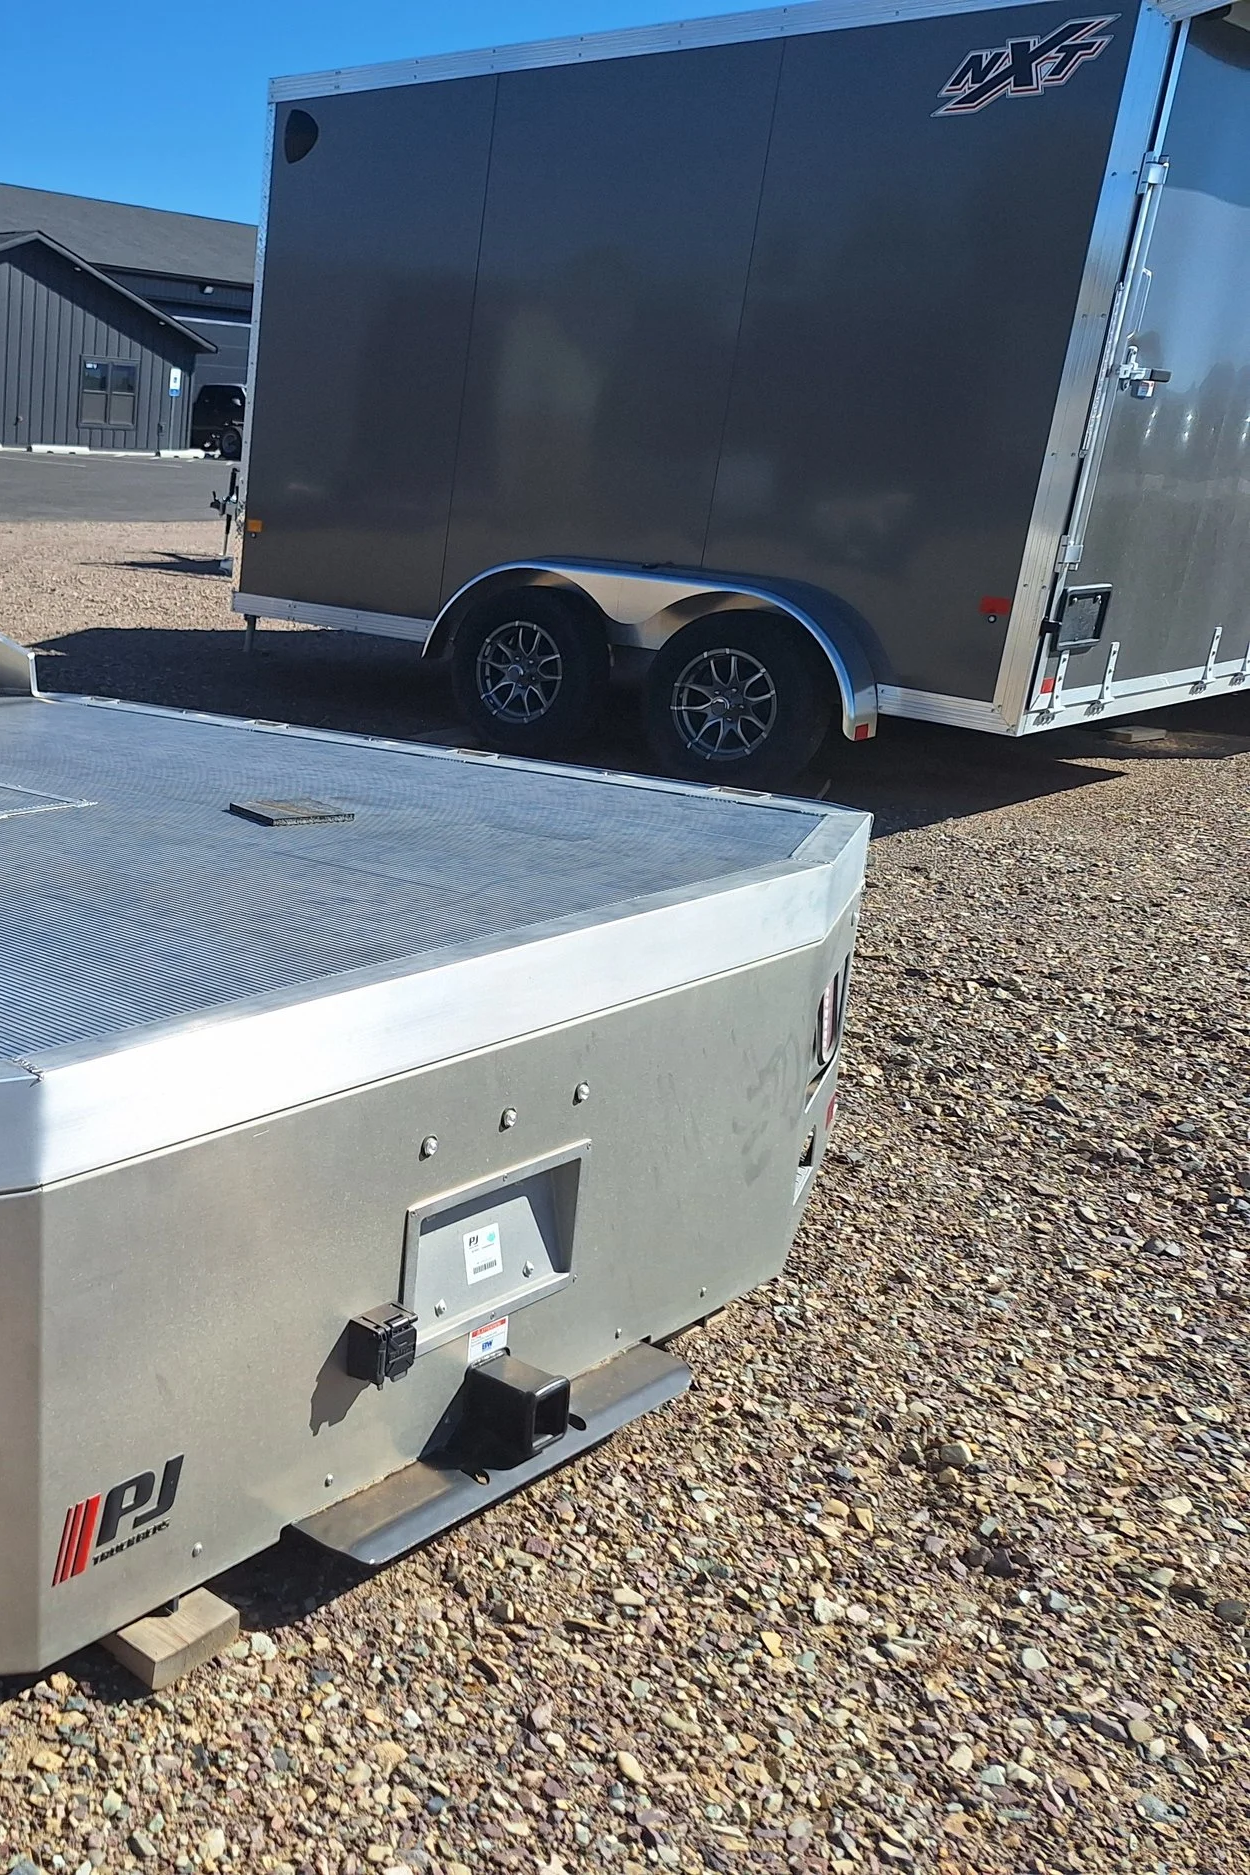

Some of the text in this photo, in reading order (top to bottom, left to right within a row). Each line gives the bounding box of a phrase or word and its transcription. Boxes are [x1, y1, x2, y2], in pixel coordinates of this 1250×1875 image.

[931, 14, 1121, 117] NXT
[468, 1234, 479, 1247] PJ
[96, 1453, 184, 1548] PJ
